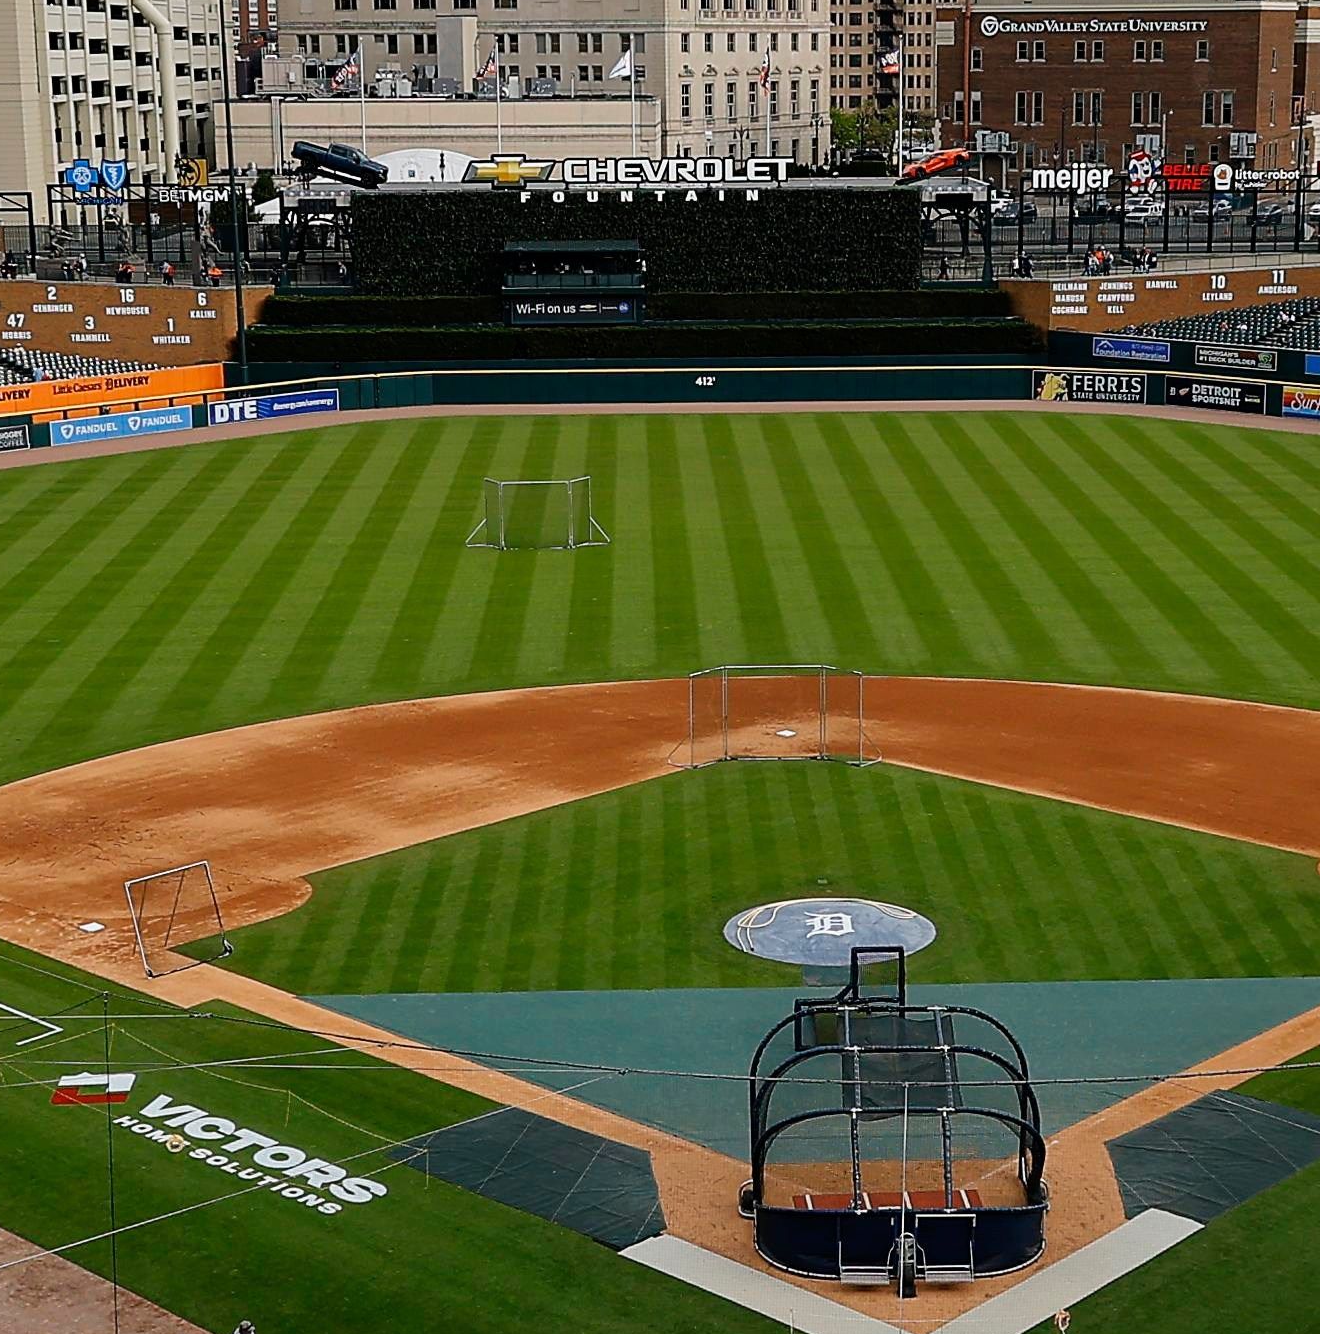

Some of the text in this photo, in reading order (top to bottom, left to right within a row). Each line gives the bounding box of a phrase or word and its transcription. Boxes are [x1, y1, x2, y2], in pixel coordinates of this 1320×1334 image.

[563, 157, 795, 182] CHEVROLET
[1162, 164, 1210, 176] BELLE
[1032, 163, 1114, 194] meijer
[1167, 178, 1203, 190] TIRE
[159, 189, 229, 202] BETMGM
[520, 189, 759, 203] FOUNTAIN
[1210, 274, 1226, 289] 10
[1271, 270, 1285, 284] 11
[1052, 282, 1088, 291] HEILMANN
[1099, 281, 1134, 290] JENNINGS
[1145, 280, 1178, 289] HARWELL
[1258, 285, 1297, 295] ANDERSON
[47, 286, 57, 300] 2
[120, 288, 135, 303] 16
[197, 292, 207, 306] 6
[1097, 293, 1136, 302] CRAWFORD
[1202, 292, 1234, 301] LEYLAND
[32, 304, 73, 313] GEHRINGER
[105, 306, 150, 315] NEWHOUSER
[190, 310, 217, 319] KALINE
[516, 303, 546, 314] Wi-Fi
[547, 306, 561, 314] on
[563, 306, 576, 314] us
[1051, 305, 1088, 315] COCHRANE
[1107, 305, 1125, 314] KELL
[6, 314, 25, 327] 47
[84, 316, 94, 330] 3
[167, 318, 174, 332] 1
[2, 331, 32, 340] MORRIS
[71, 333, 111, 342] TRAMMELL
[152, 335, 191, 344] WHITAKER
[1199, 349, 1239, 358] MICHIGAN'S
[73, 376, 149, 393] Caesars DELIVERY
[694, 375, 716, 387] 412'
[1072, 375, 1142, 393] FERRIS
[1072, 391, 1140, 402] STATE UNIVERSITY
[1192, 384, 1242, 398] DETROIT
[1192, 394, 1241, 407] SPORTSNET
[214, 400, 257, 423] DTE
[141, 414, 183, 428] FANDUEL
[75, 421, 118, 435] FANDUEL
[138, 1093, 388, 1204] VICTORS
[188, 1147, 343, 1217] SOLUTIONS
